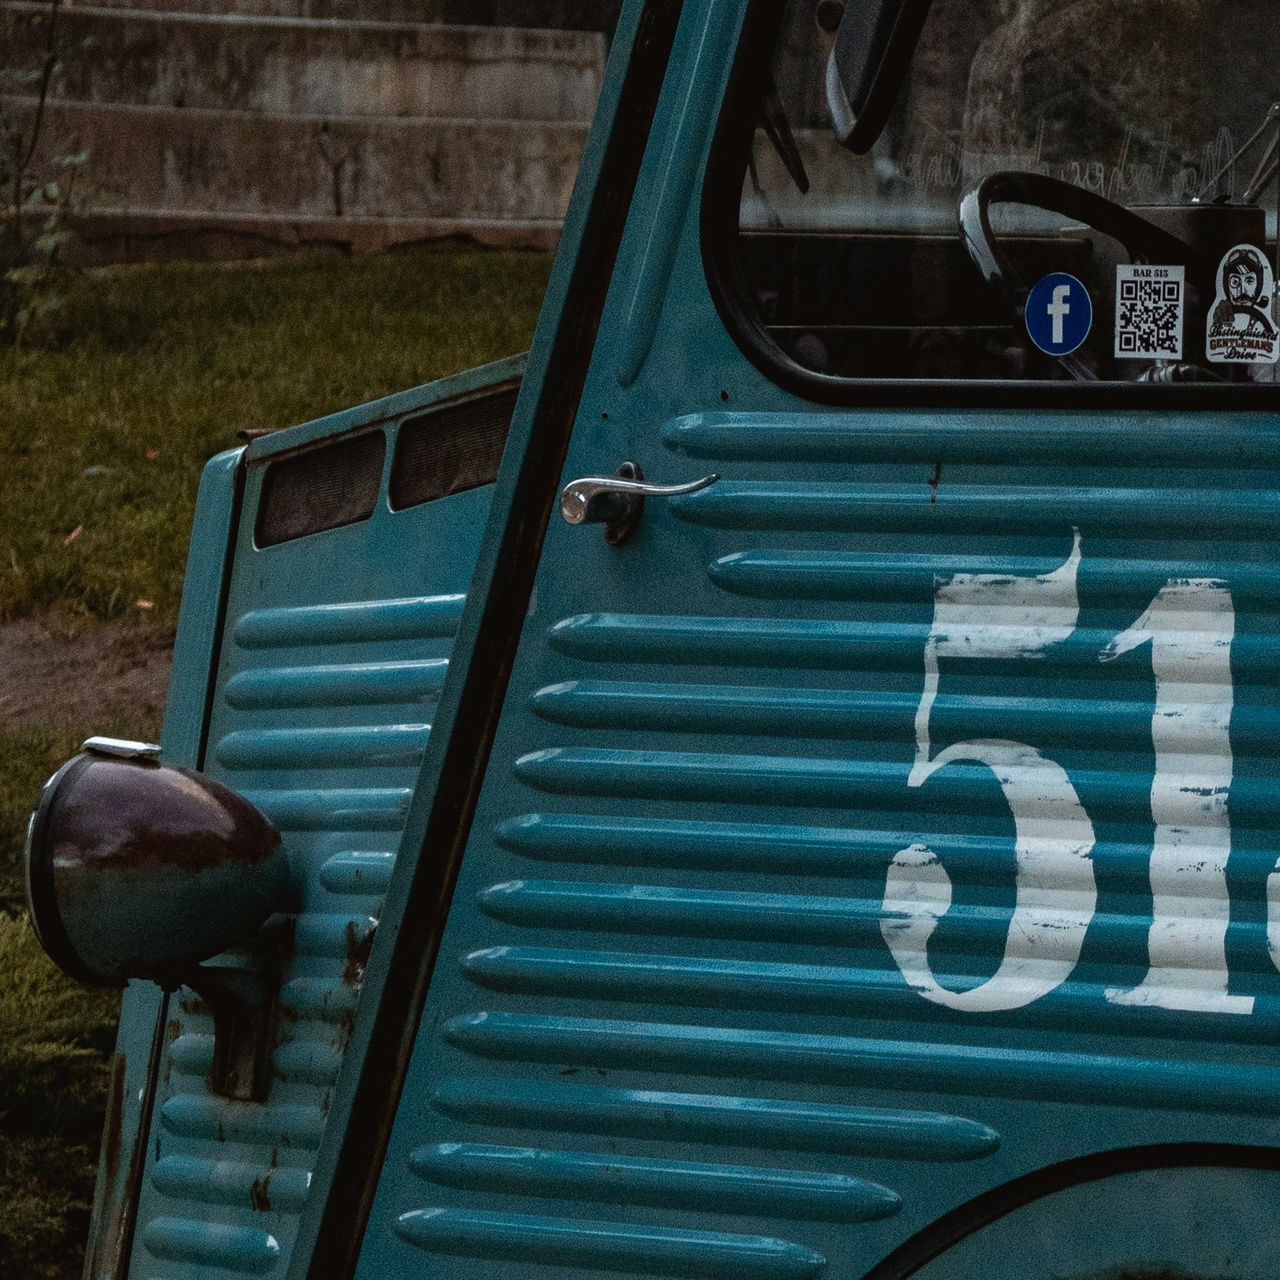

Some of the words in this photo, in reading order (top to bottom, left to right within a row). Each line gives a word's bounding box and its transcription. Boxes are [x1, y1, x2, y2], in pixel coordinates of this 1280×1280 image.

[1133, 269, 1152, 278] BAR
[1208, 324, 1280, 341] Distinguished
[1224, 346, 1257, 360] Drive
